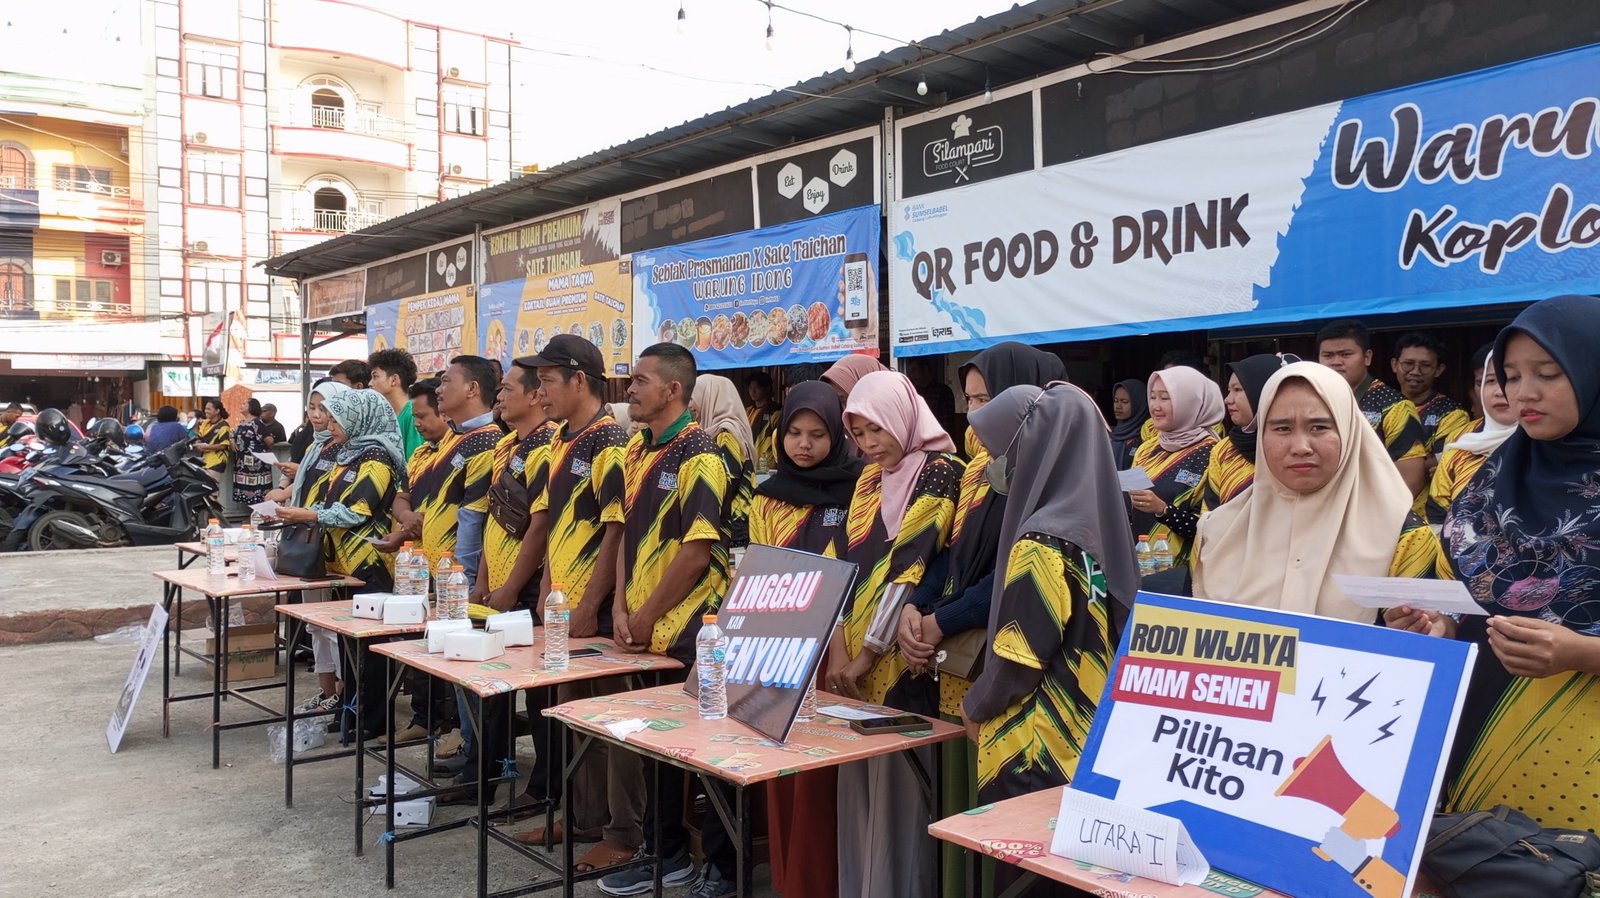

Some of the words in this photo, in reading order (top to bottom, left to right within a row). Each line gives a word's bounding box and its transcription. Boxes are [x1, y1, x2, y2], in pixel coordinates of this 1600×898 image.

[933, 132, 994, 165] Silampari
[1332, 97, 1600, 192] Waru
[784, 175, 795, 187] Eat
[832, 162, 854, 176] Drink
[807, 189, 825, 204] Enjoy
[490, 231, 518, 256] KOKTAIL
[520, 224, 540, 249] BUAH
[542, 215, 581, 243] PREMIUM
[911, 247, 956, 300] QR
[963, 229, 1059, 285] FOOD
[1069, 221, 1099, 269] &
[1112, 192, 1251, 266] DRINK
[526, 258, 545, 277] SATE
[652, 259, 686, 285] Seblak
[687, 251, 750, 279] Prasmanan
[753, 248, 762, 268] X
[763, 245, 790, 266] Sate
[793, 234, 846, 262] Taichan
[548, 276, 569, 291] MAMA
[726, 570, 823, 611] LINGGAU
[726, 616, 745, 630] KAN
[724, 636, 819, 689] ENYUM
[1130, 623, 1190, 656] RODI
[1193, 628, 1297, 668] WIJAYA
[1119, 664, 1190, 700] IMAM
[1191, 672, 1271, 711] SENEN
[1152, 714, 1284, 776] Pilihan
[1166, 752, 1245, 801] Kito
[1079, 818, 1141, 854] UTARA
